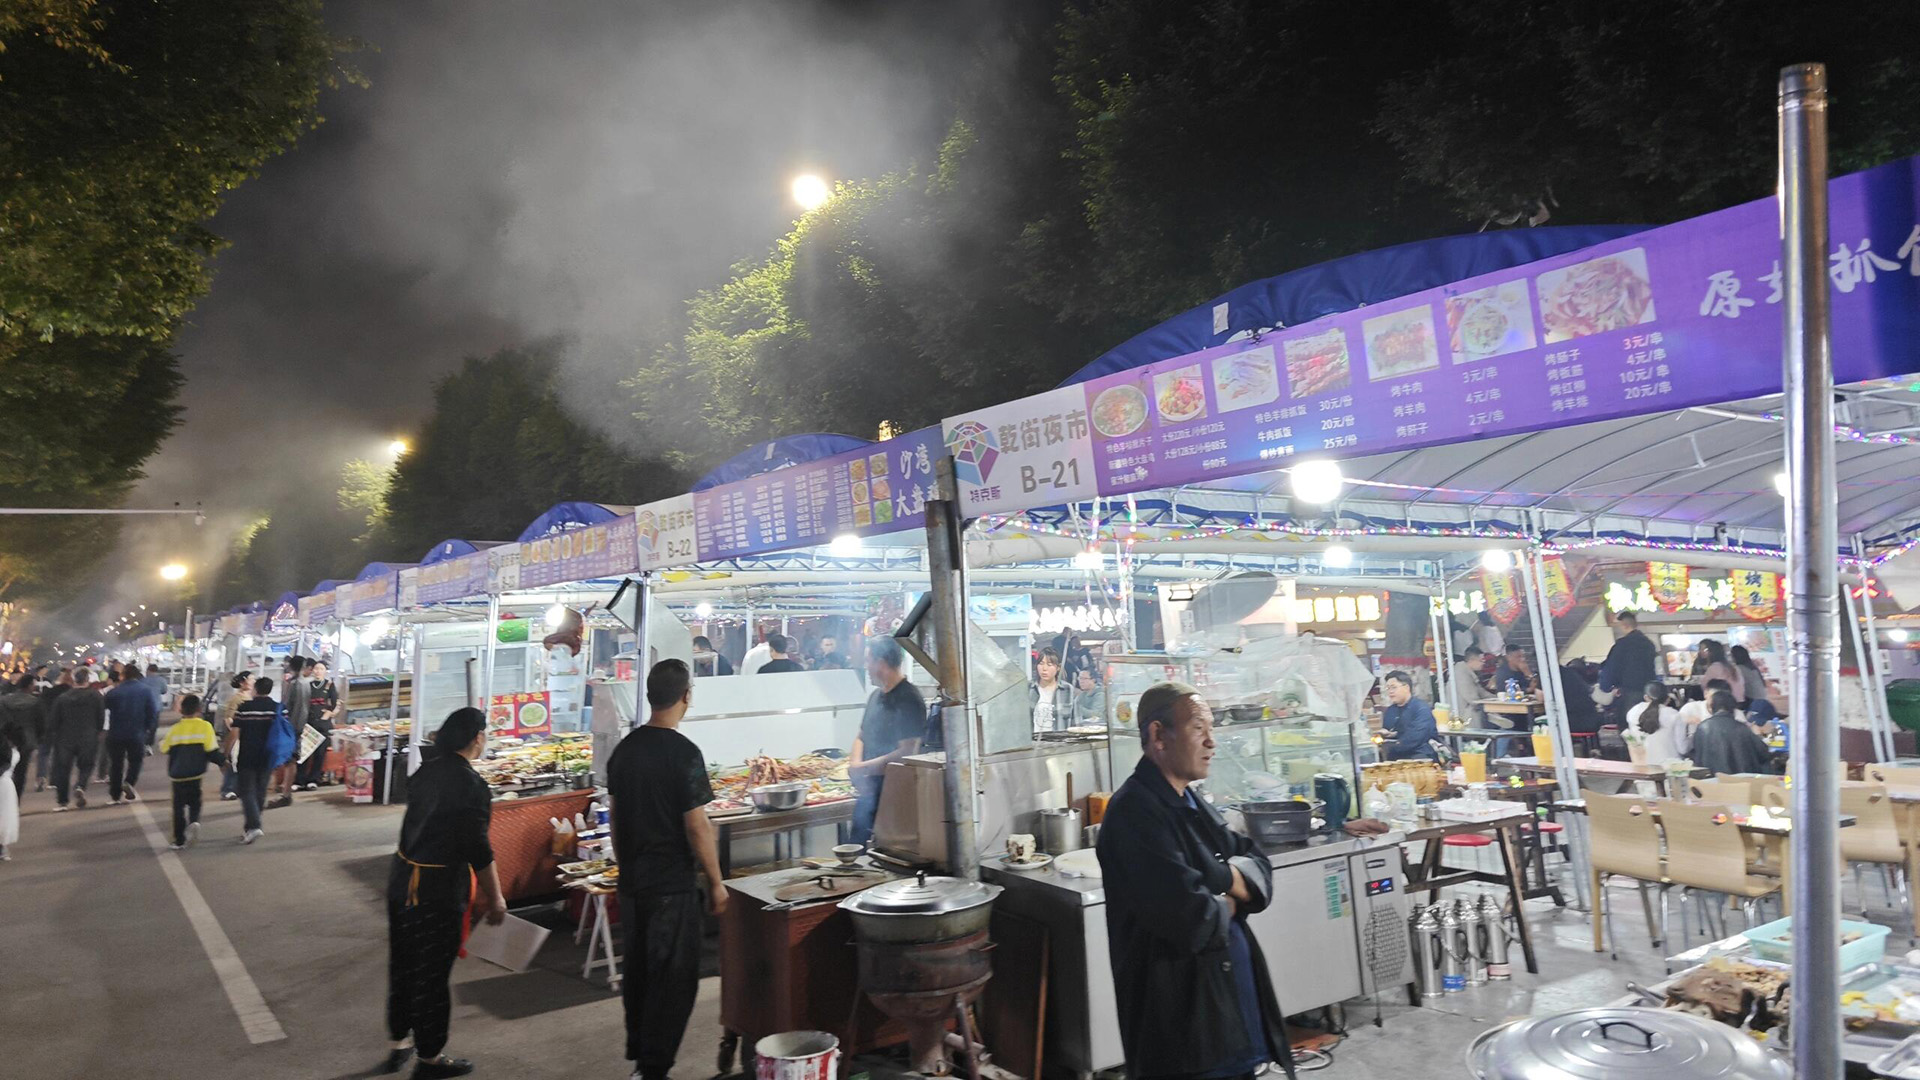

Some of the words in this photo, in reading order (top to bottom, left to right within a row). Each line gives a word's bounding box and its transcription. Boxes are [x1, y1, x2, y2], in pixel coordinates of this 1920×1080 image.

[1623, 332, 1663, 350] 3元/串
[1626, 348, 1667, 365] 4元/串
[1462, 366, 1498, 383] 3元/串
[1391, 381, 1423, 397] 烤牛肉
[1465, 388, 1502, 404] 4元/串
[1624, 381, 1672, 400] 20元/串
[1319, 395, 1354, 412] 30元/份
[1393, 402, 1427, 417] 烤羊肉
[1321, 415, 1355, 430] 20元/份
[1468, 410, 1505, 426] 2元/串
[1323, 434, 1357, 449] 25元/份
[1021, 458, 1080, 493] B-21
